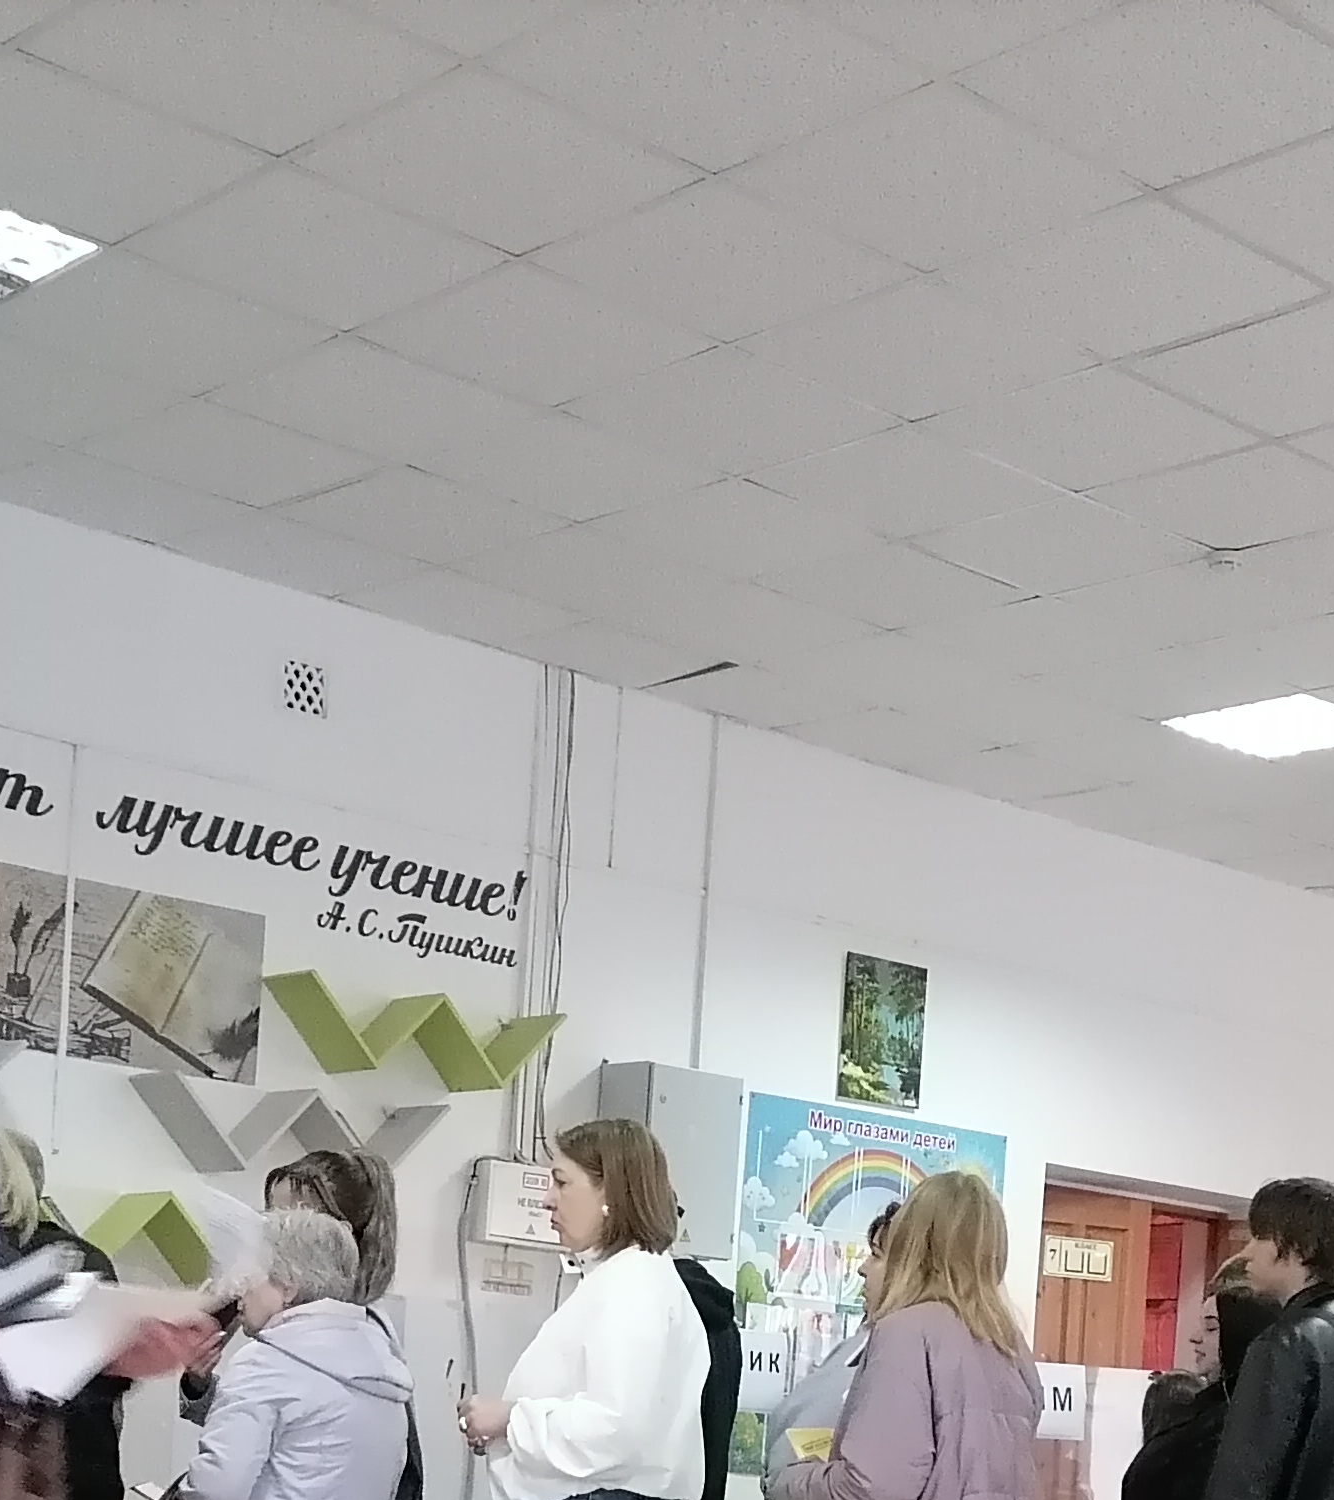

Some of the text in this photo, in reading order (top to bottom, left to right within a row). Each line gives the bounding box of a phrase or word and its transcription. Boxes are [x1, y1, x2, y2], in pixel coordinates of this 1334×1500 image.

[95, 795, 321, 872] лучшее
[328, 844, 528, 922] учение!
[809, 1110, 956, 1150] Мир глазами детей
[1049, 1248, 1058, 1260] 7
